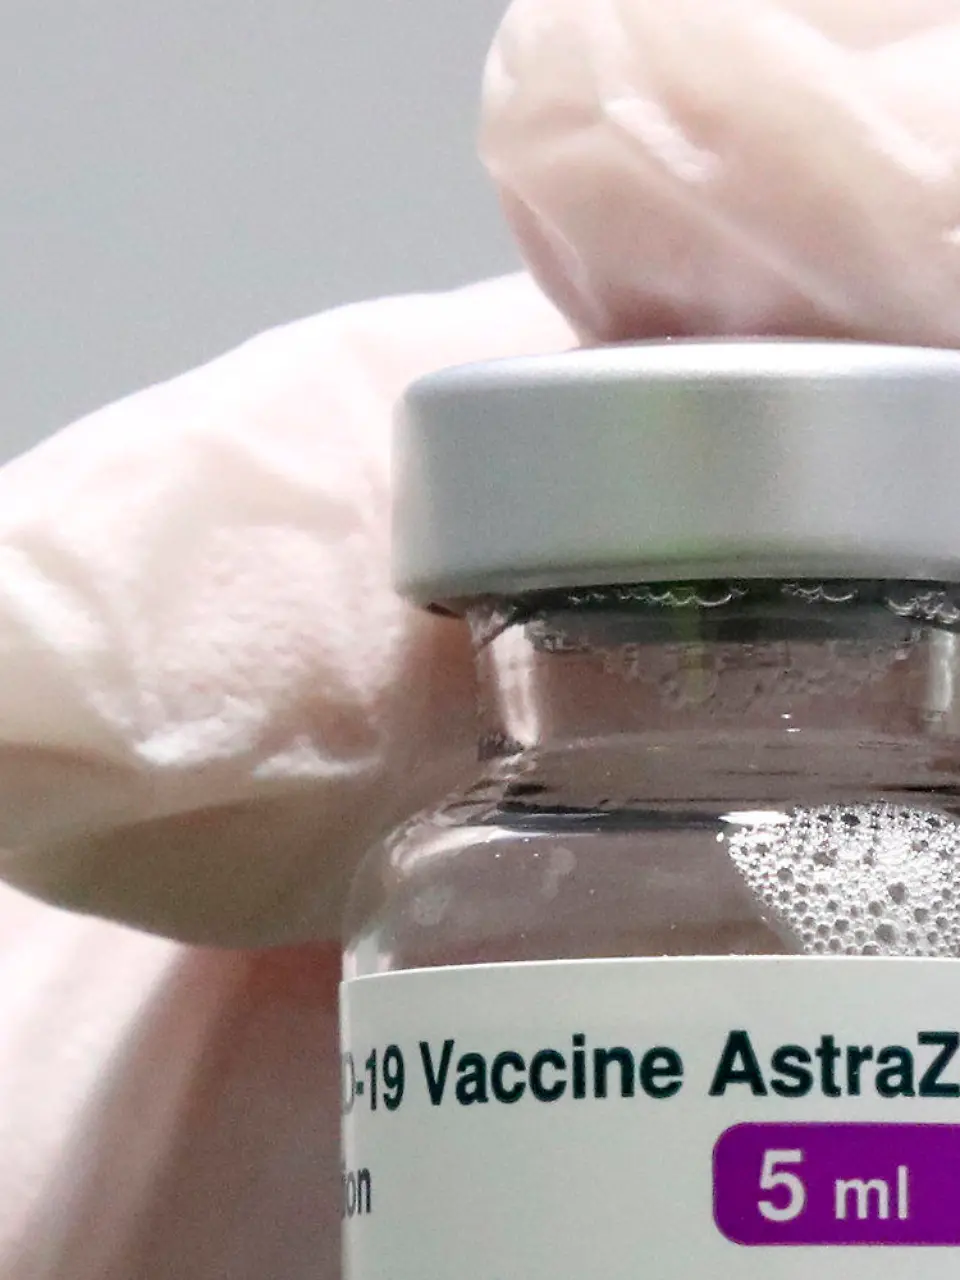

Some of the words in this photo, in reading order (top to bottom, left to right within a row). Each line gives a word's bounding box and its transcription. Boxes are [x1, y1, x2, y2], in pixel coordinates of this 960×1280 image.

[418, 1032, 685, 1107] Vaccine
[345, 1167, 372, 1218] on
[757, 1149, 805, 1222] 5
[834, 1165, 909, 1220] ml
